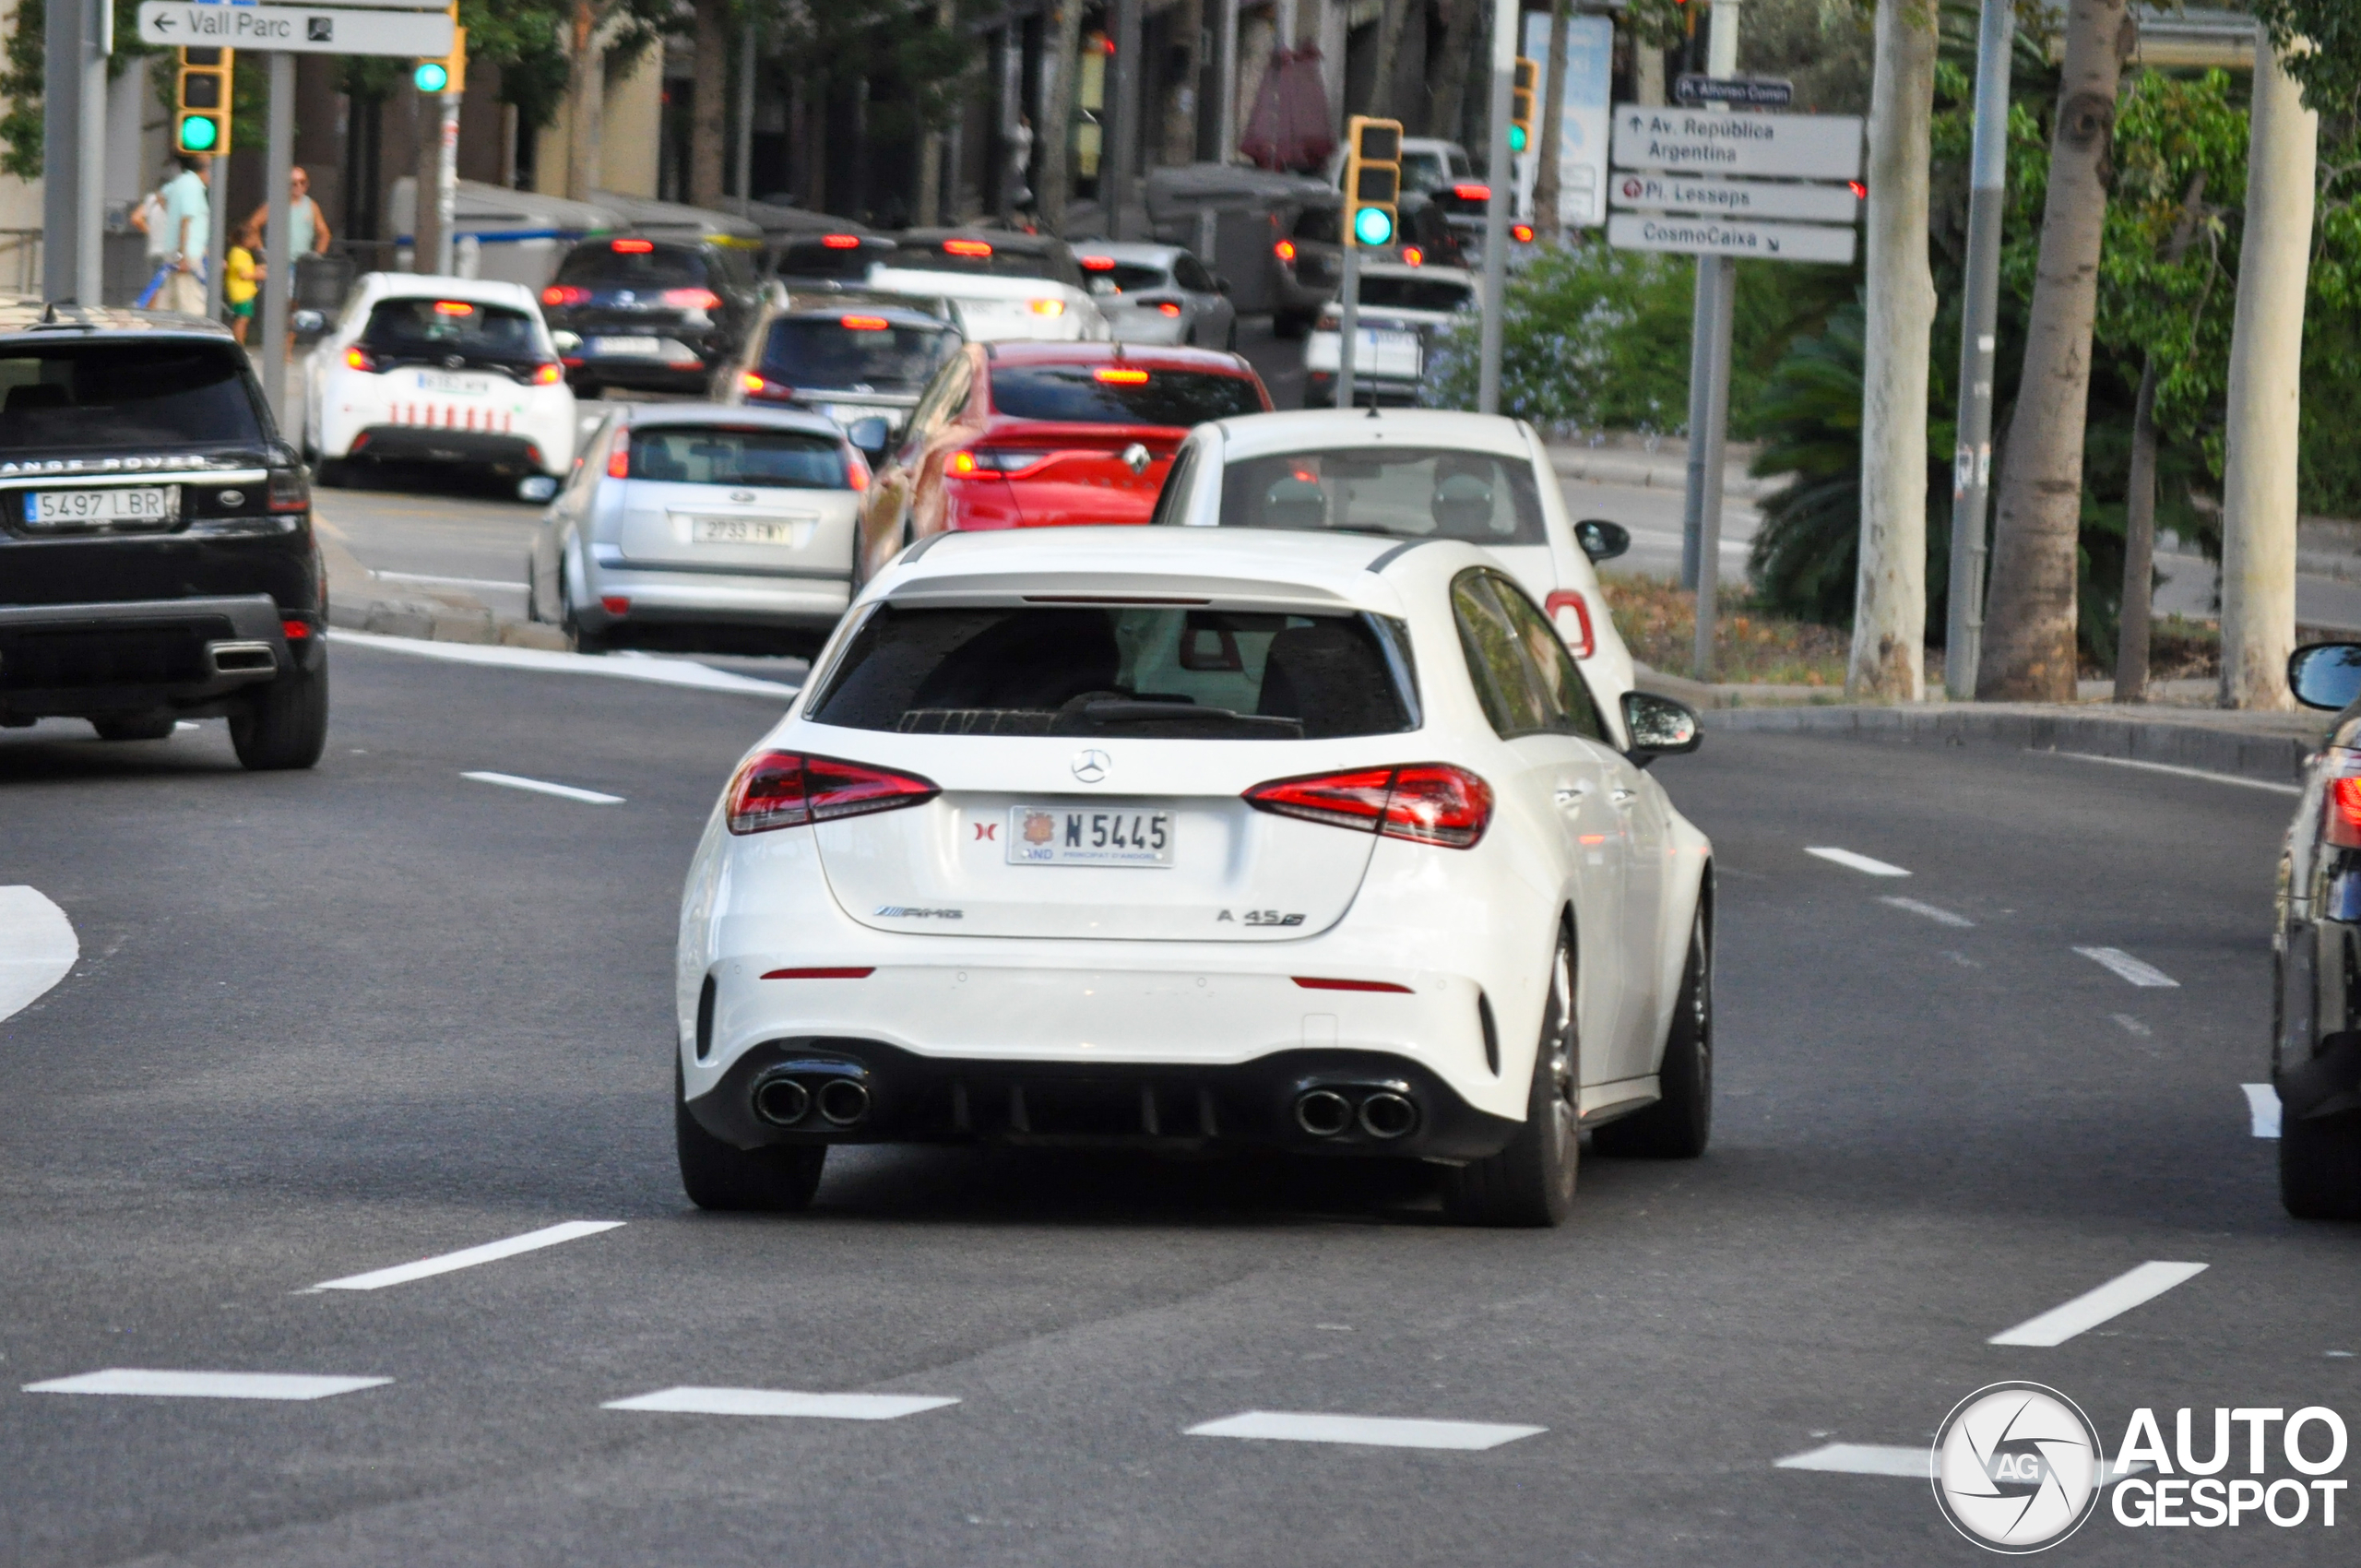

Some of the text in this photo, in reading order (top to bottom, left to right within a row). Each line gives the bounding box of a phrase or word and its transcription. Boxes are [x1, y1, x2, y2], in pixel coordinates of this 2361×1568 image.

[187, 9, 291, 38] Vall Parc
[1650, 116, 1774, 140] Av. República
[1648, 140, 1737, 162] Argentina
[1645, 180, 1750, 208] Pl. Lesseps
[1643, 221, 1758, 247] CosmoCaixa
[0, 456, 206, 474] ANGE ROVER
[42, 493, 102, 517] 5497
[113, 493, 160, 516] LBR
[1064, 814, 1168, 849] N 5445
[1063, 850, 1109, 859] PRINCIPAT
[1216, 909, 1235, 921] A
